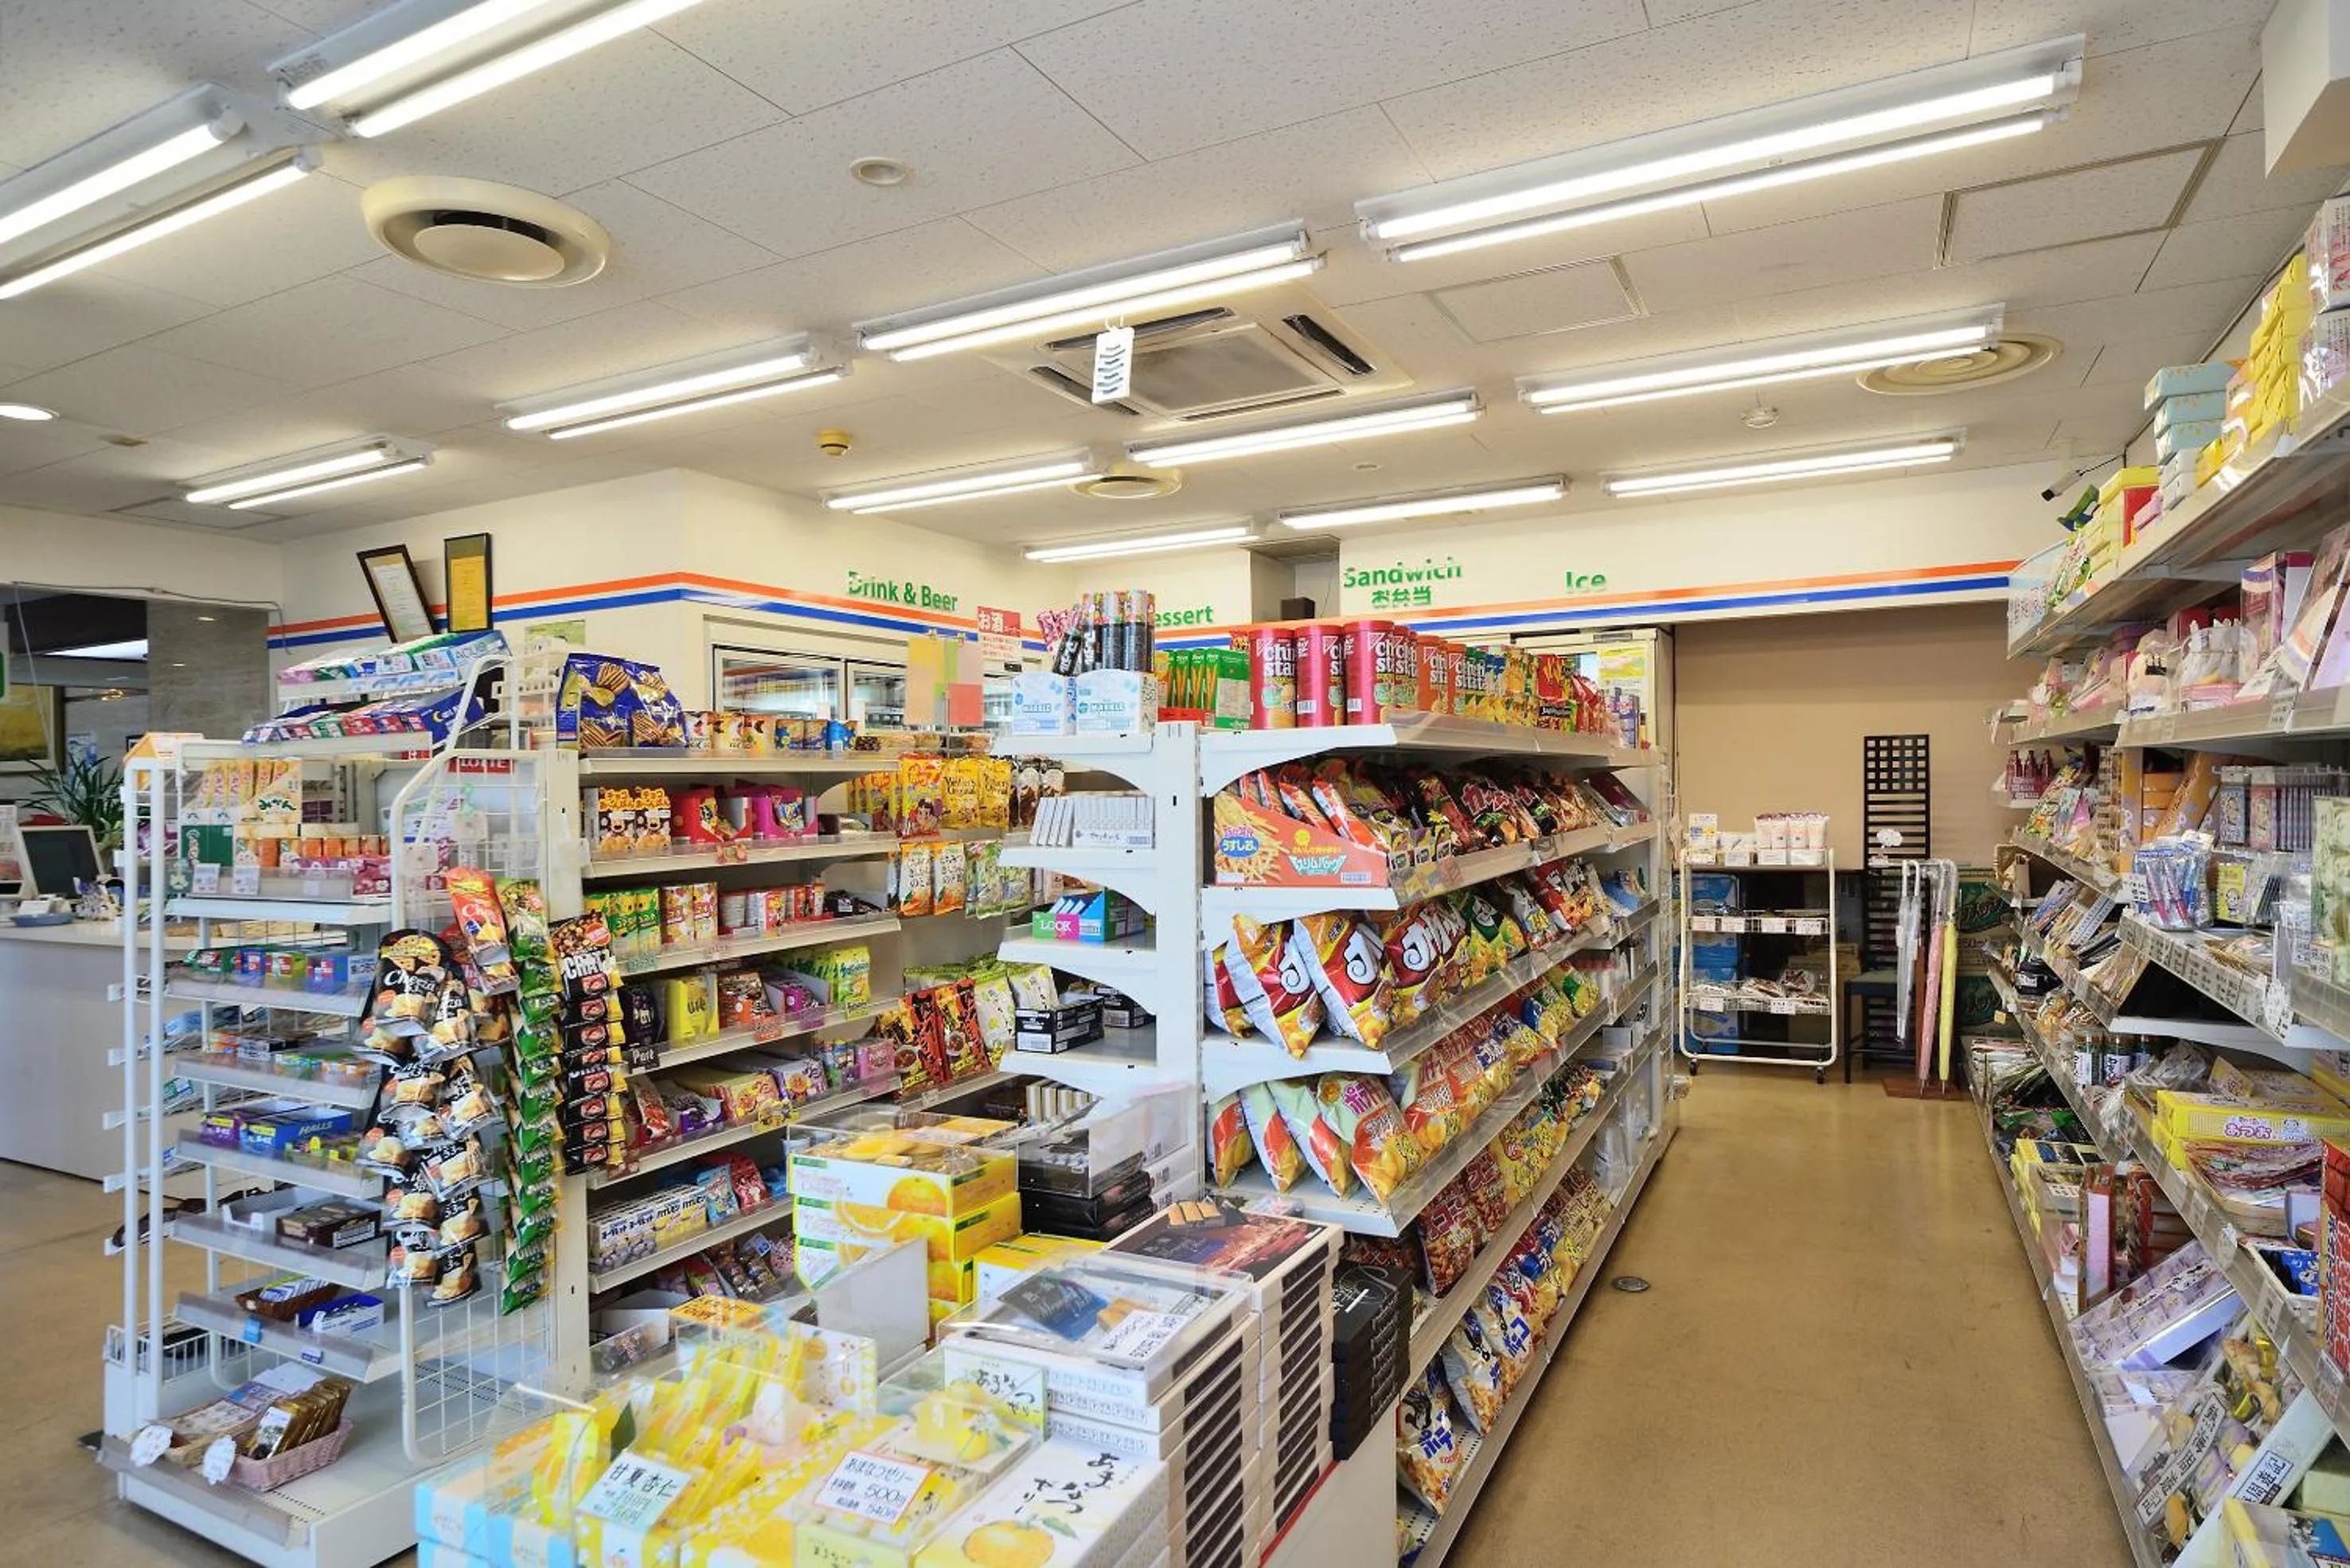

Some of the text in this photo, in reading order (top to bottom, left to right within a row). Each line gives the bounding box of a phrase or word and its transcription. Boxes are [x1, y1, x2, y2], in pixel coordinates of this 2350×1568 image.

[1343, 556, 1462, 588] Sandwich
[1565, 571, 1606, 590] Ice
[848, 571, 958, 612] Drink & Beer
[1154, 605, 1215, 627] essert
[1040, 920, 1072, 932] LOOK
